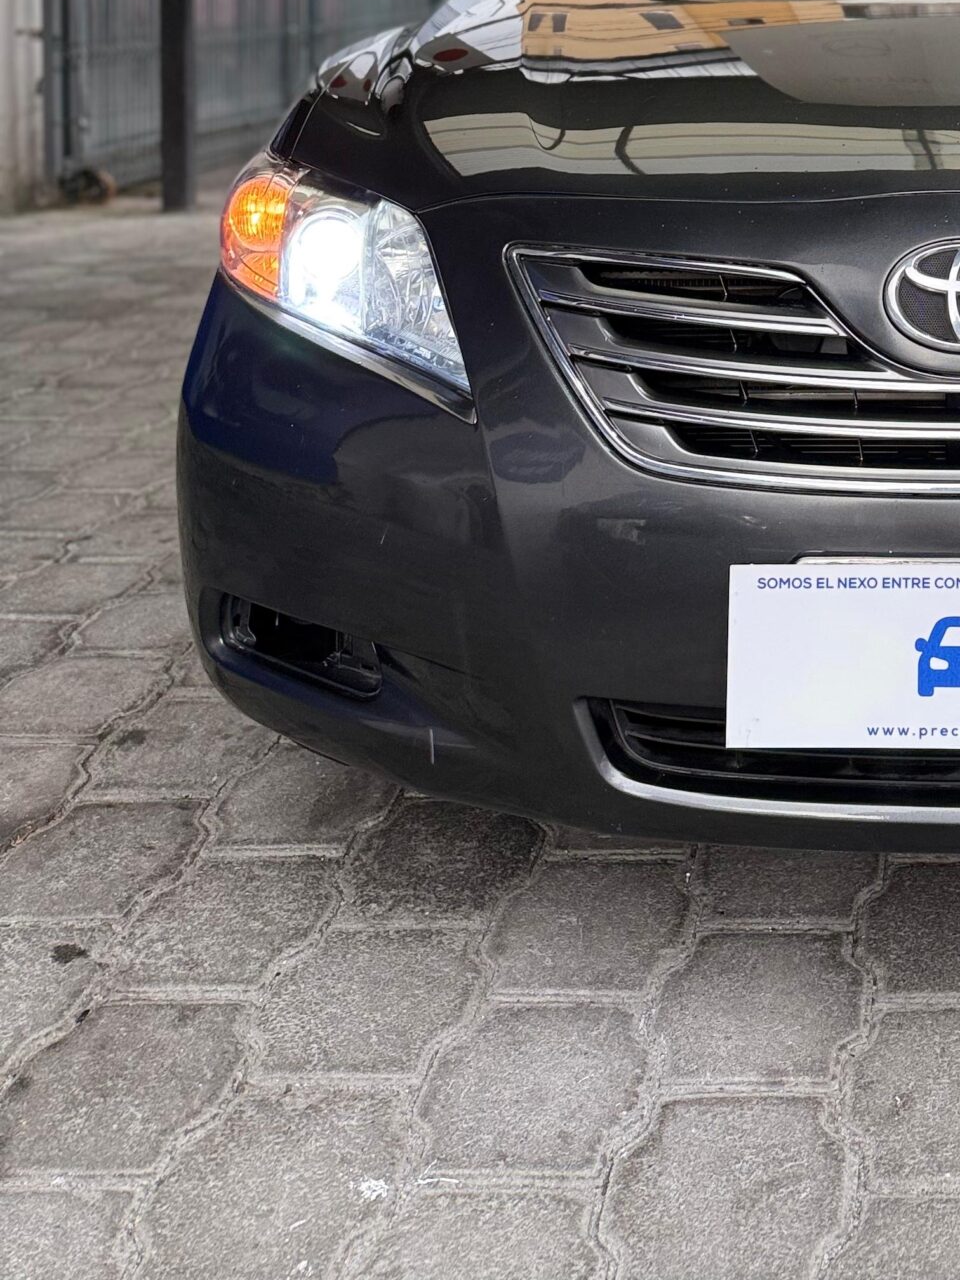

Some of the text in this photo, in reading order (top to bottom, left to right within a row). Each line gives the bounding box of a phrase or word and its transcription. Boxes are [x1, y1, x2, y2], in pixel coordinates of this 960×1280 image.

[757, 577, 813, 590] SOMOS
[816, 577, 834, 590] EL
[837, 577, 878, 590] NEXO
[882, 577, 931, 590] ENTRE
